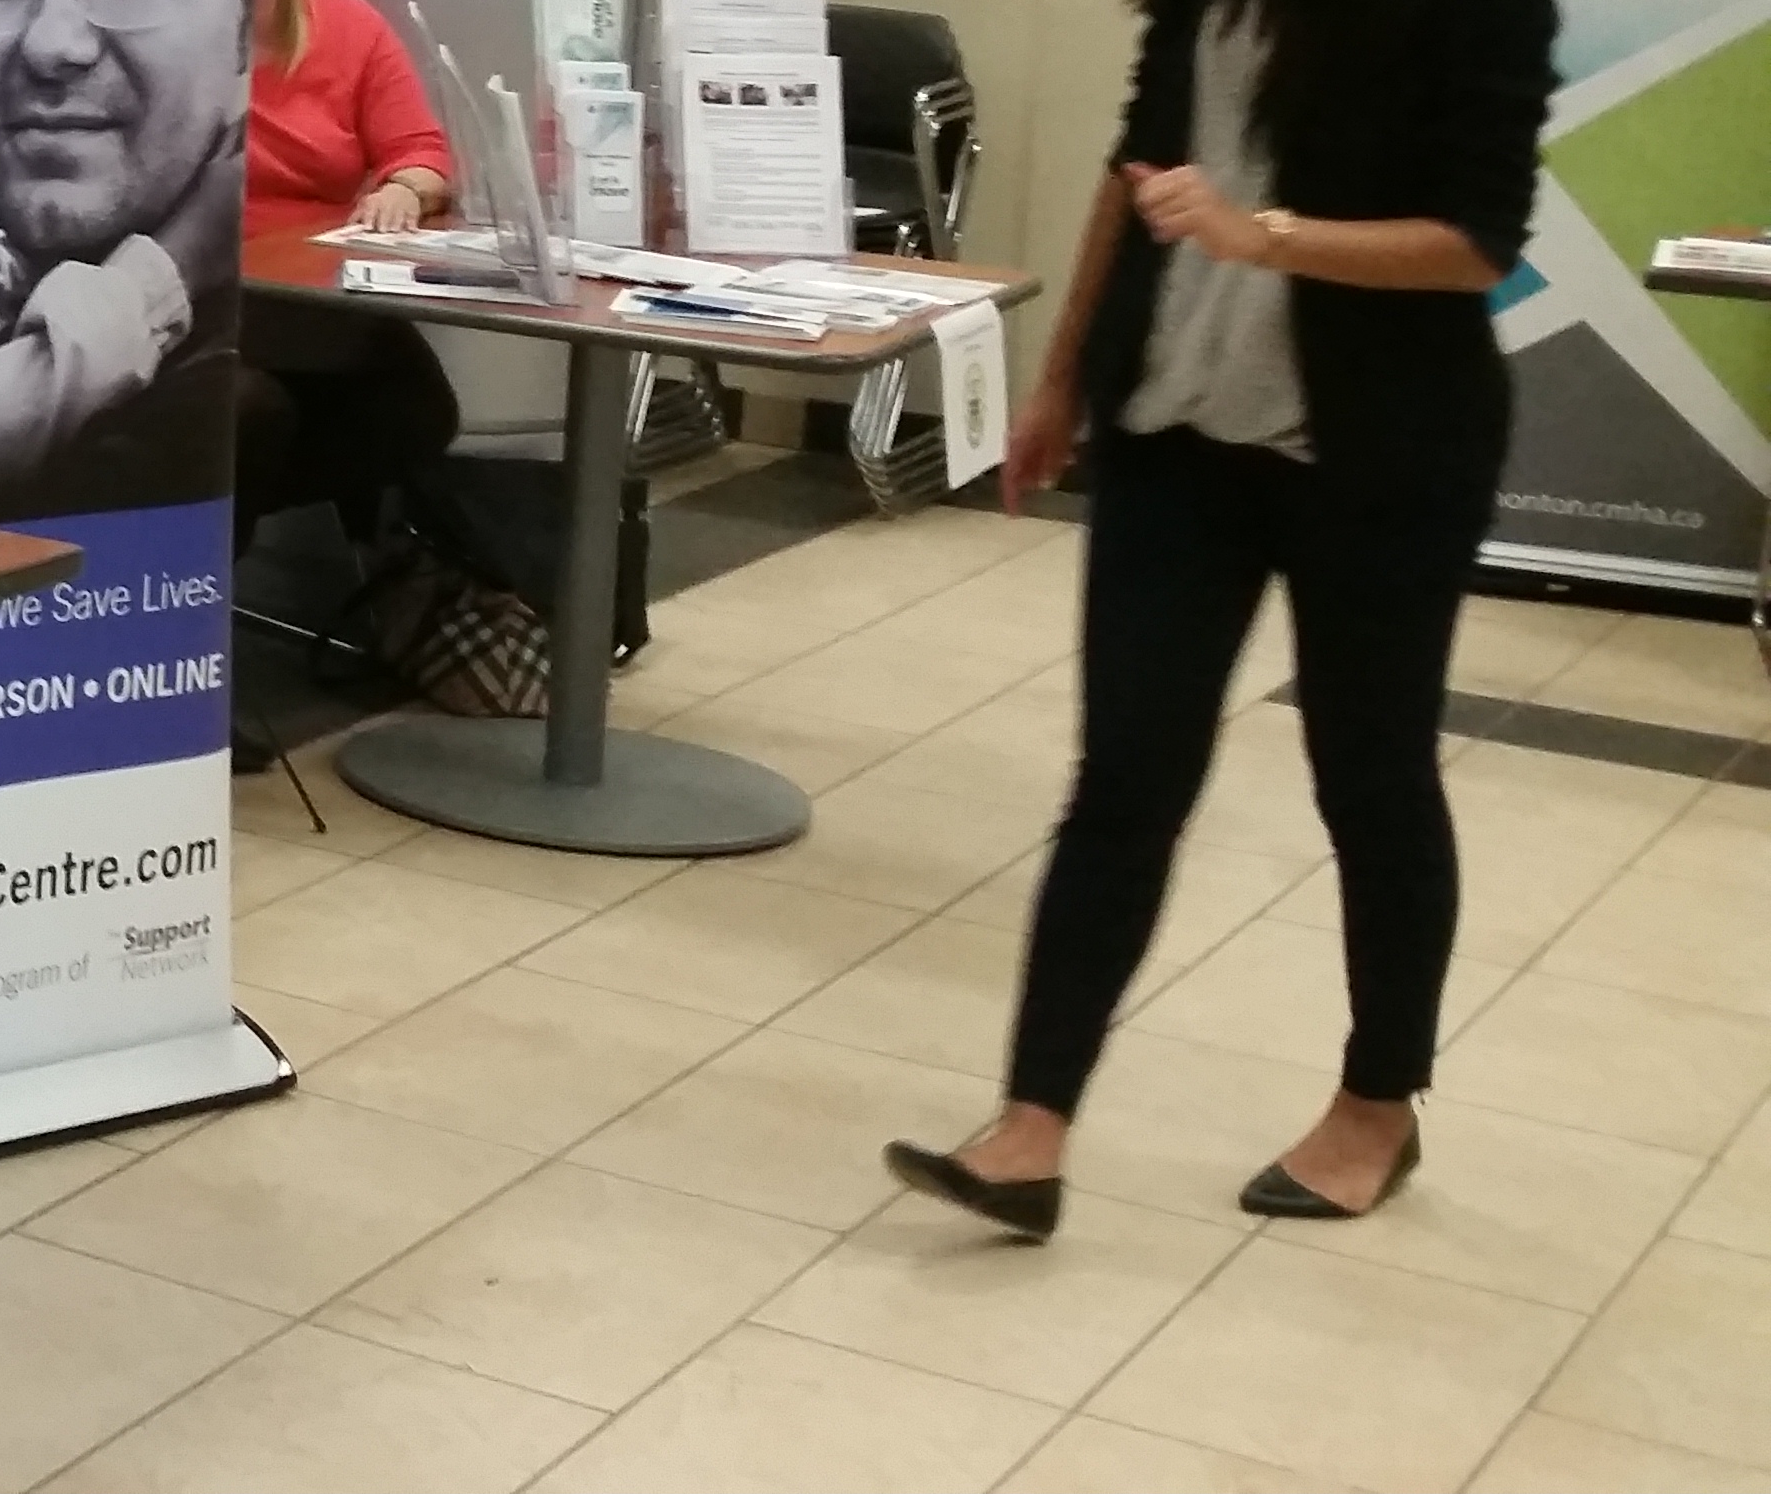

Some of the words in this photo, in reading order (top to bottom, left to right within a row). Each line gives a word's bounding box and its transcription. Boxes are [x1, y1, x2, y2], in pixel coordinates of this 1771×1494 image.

[51, 581, 132, 623] Save
[142, 572, 223, 613] Lives.
[108, 653, 225, 703] ONLINE
[124, 914, 210, 952] Support
[67, 953, 91, 982] of
[122, 952, 209, 980] Network
